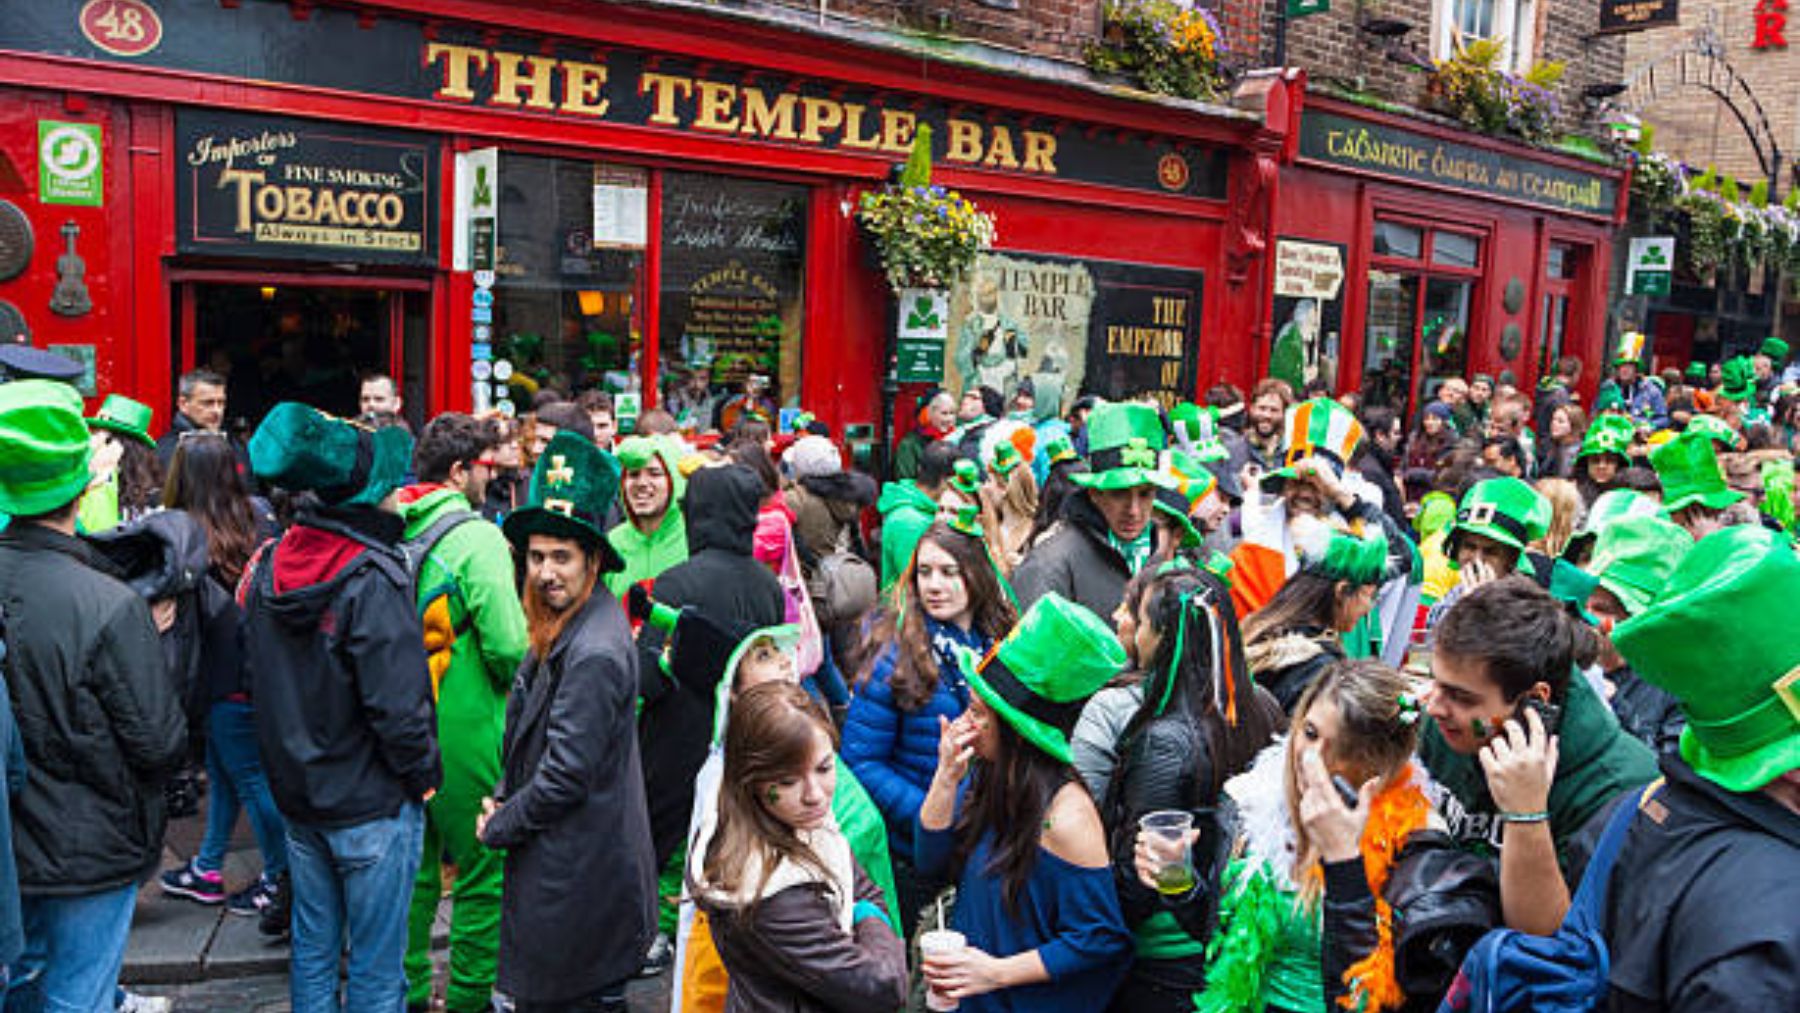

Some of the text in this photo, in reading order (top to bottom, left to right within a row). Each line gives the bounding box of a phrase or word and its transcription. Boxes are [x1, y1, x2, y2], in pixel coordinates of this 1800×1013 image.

[95, 3, 145, 42] 48
[424, 43, 1057, 174] THE TEMPLE BAR
[187, 131, 296, 168] Importers
[284, 164, 404, 189] FINE SMOKING
[217, 169, 404, 233] TOBACCO
[260, 222, 418, 247] Always in Stock
[995, 267, 1089, 298] TEMPLE
[1023, 293, 1067, 322] BAR
[1152, 296, 1187, 326] THE
